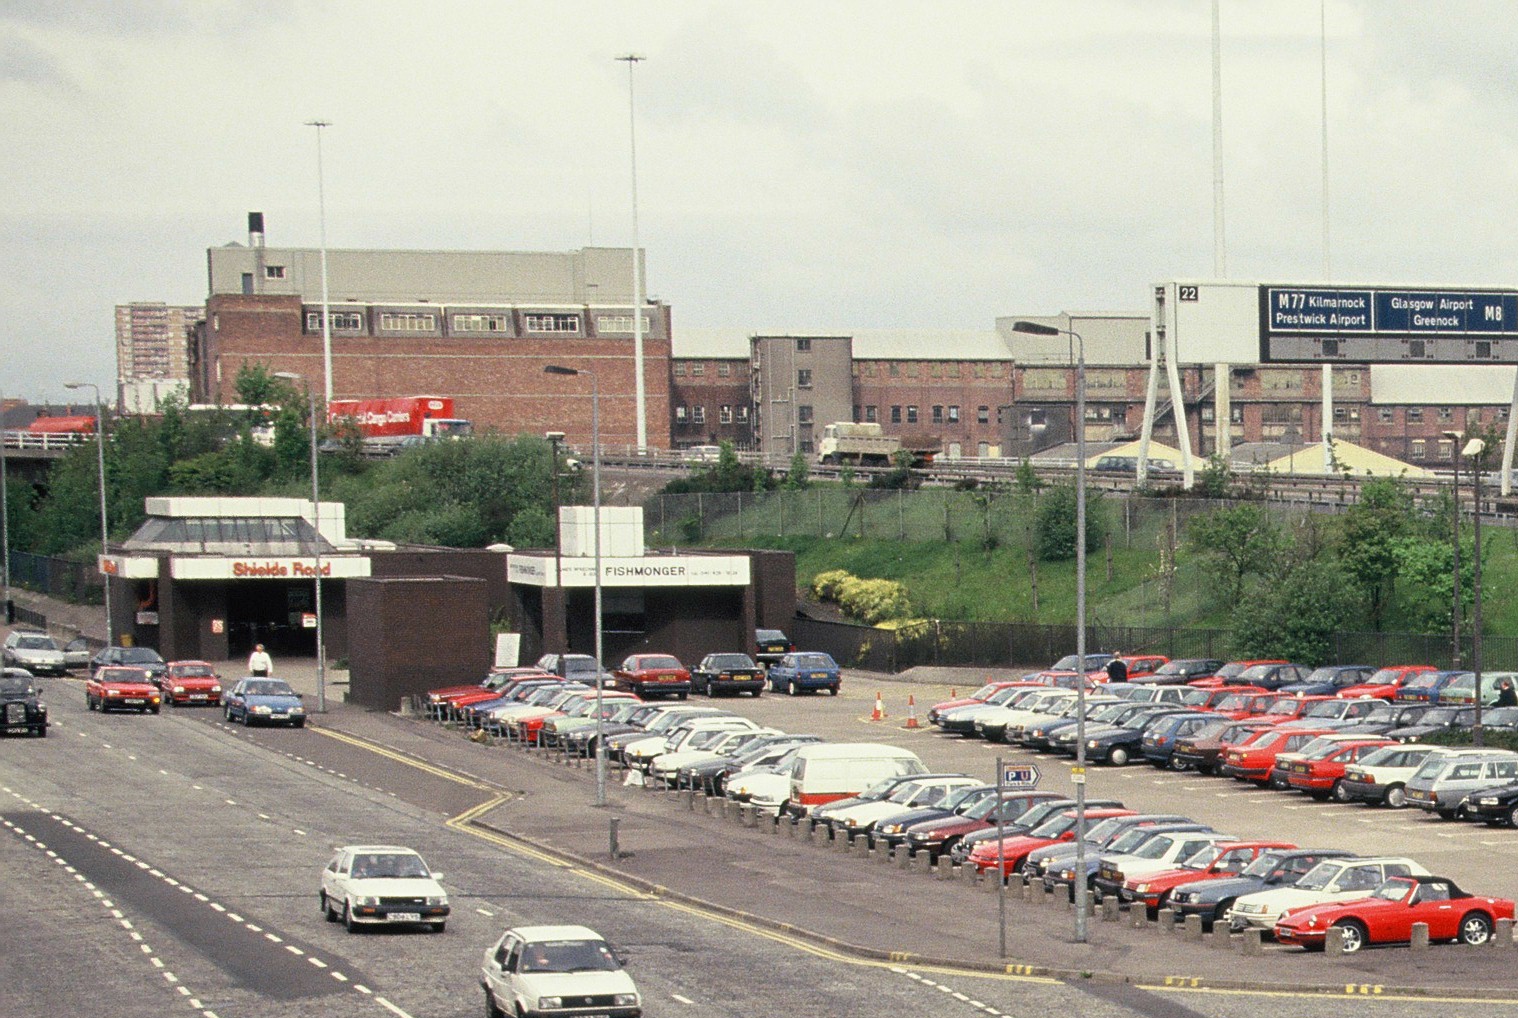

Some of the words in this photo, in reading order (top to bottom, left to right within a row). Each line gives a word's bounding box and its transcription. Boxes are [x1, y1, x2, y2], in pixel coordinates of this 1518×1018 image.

[1181, 287, 1196, 299] 22
[1279, 293, 1306, 308] M77
[1308, 296, 1366, 309] Kilmarnock
[1391, 296, 1434, 311] Glasgow
[1438, 298, 1474, 311] Airport
[1276, 312, 1327, 325] Prestwick
[1329, 313, 1366, 327] Airport
[1413, 314, 1460, 327] Greenock
[1485, 306, 1503, 322] M8
[233, 561, 288, 577] Shields
[605, 566, 686, 576] FISHMONGER
